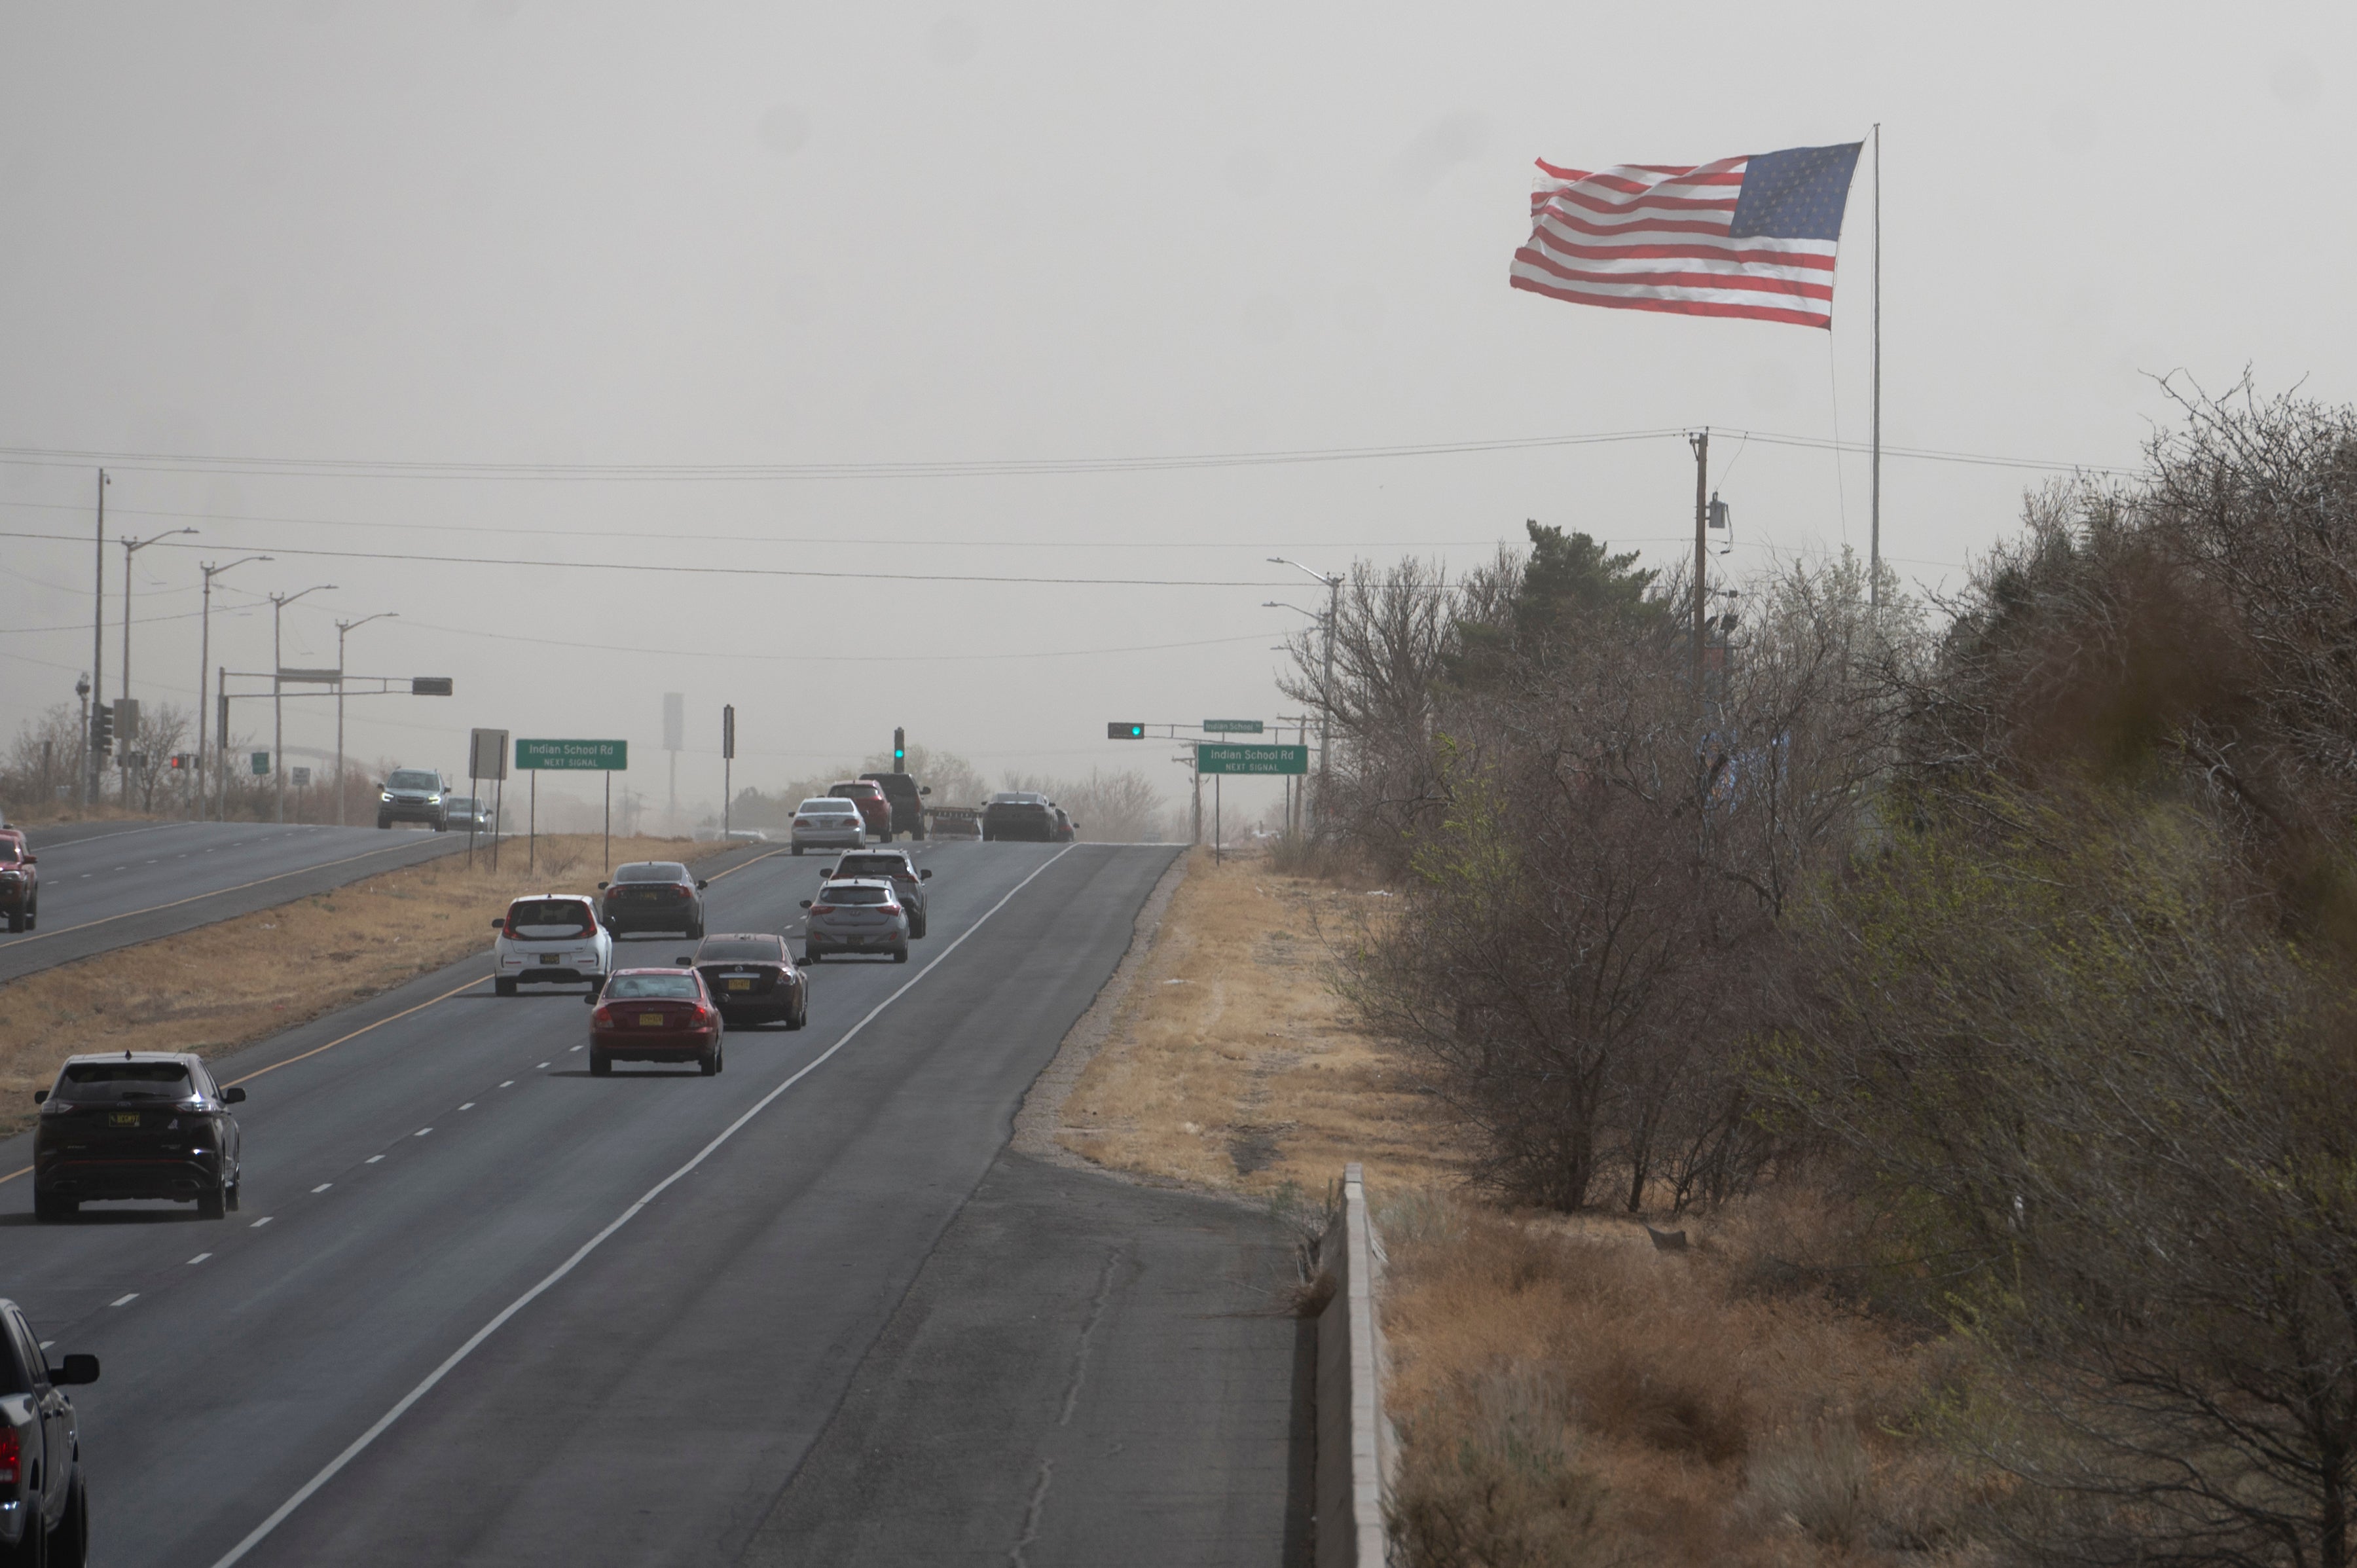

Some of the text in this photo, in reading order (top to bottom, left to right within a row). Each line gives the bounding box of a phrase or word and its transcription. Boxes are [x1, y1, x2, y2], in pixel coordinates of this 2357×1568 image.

[1230, 723, 1253, 731] School
[529, 744, 613, 755] Indian School Rd
[1211, 750, 1294, 760] Indian School Rd
[544, 758, 598, 767] NEXT SIGNAL
